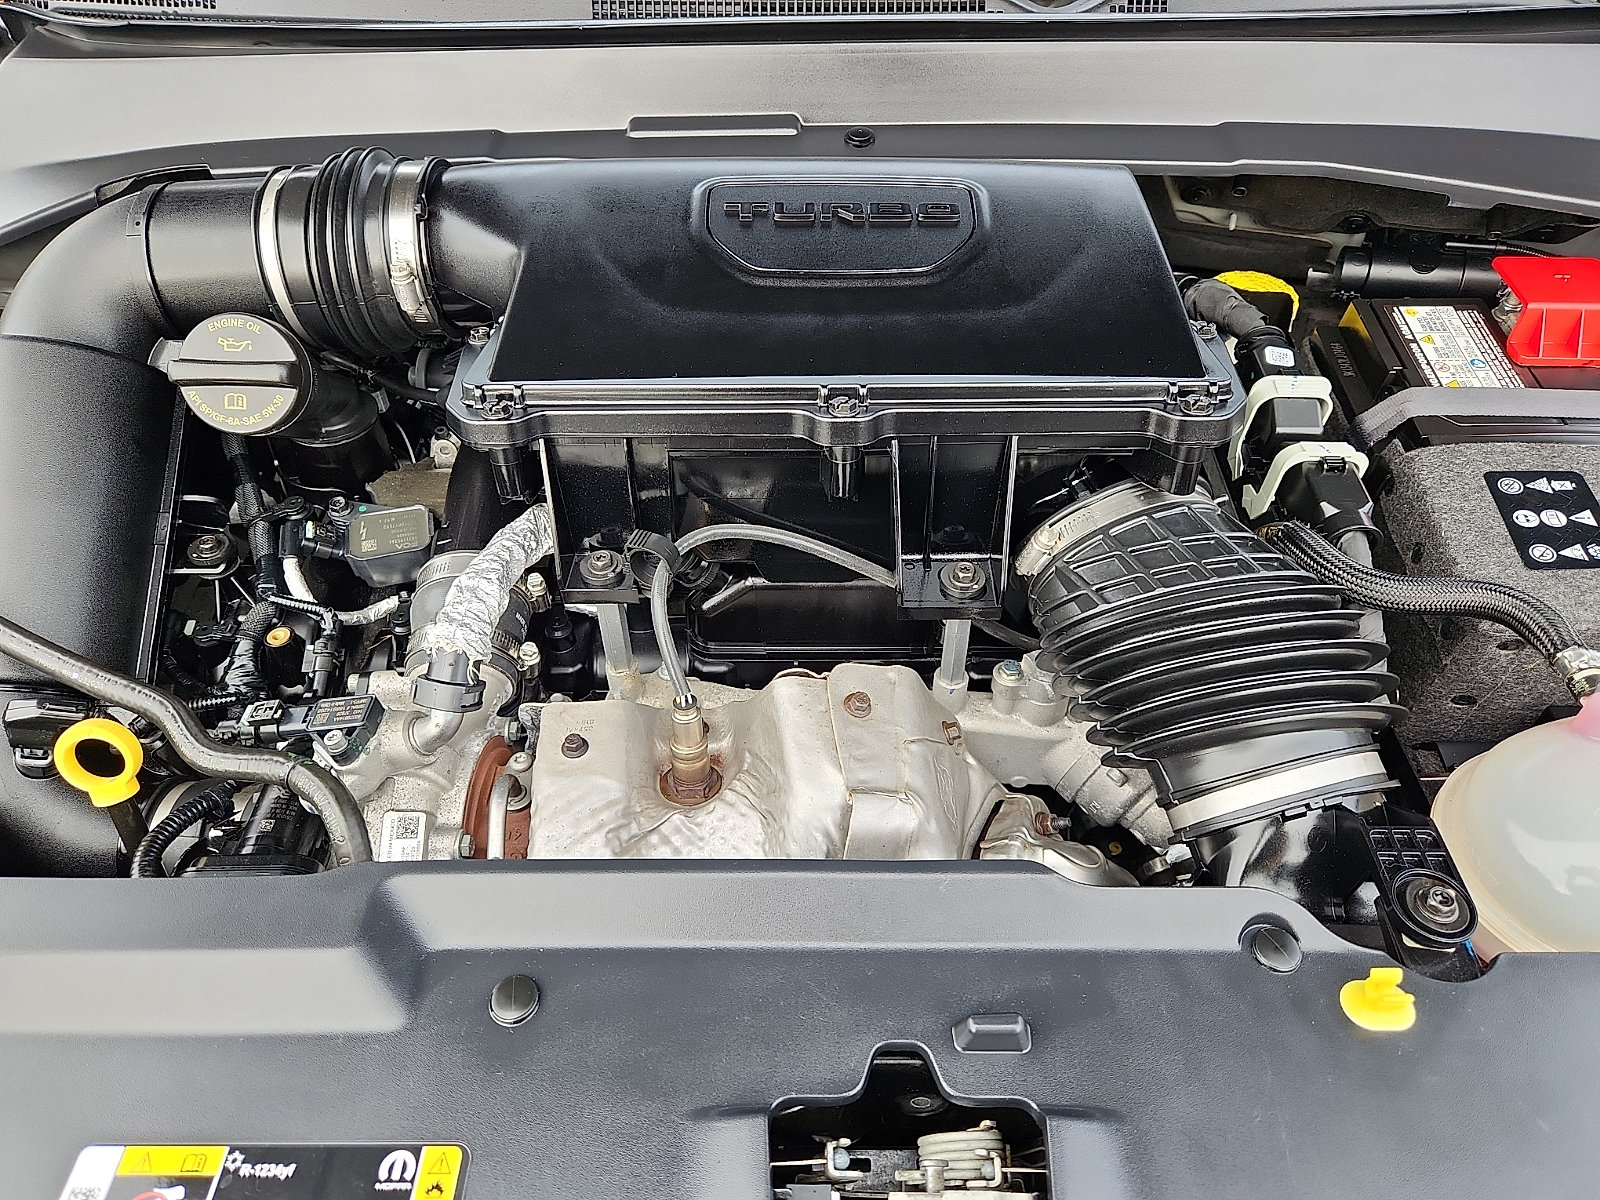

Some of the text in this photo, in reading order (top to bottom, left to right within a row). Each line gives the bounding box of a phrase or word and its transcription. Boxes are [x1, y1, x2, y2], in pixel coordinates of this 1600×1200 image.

[724, 202, 960, 222] TURBO
[208, 319, 262, 334] ENGINE OIL
[188, 391, 201, 407] API
